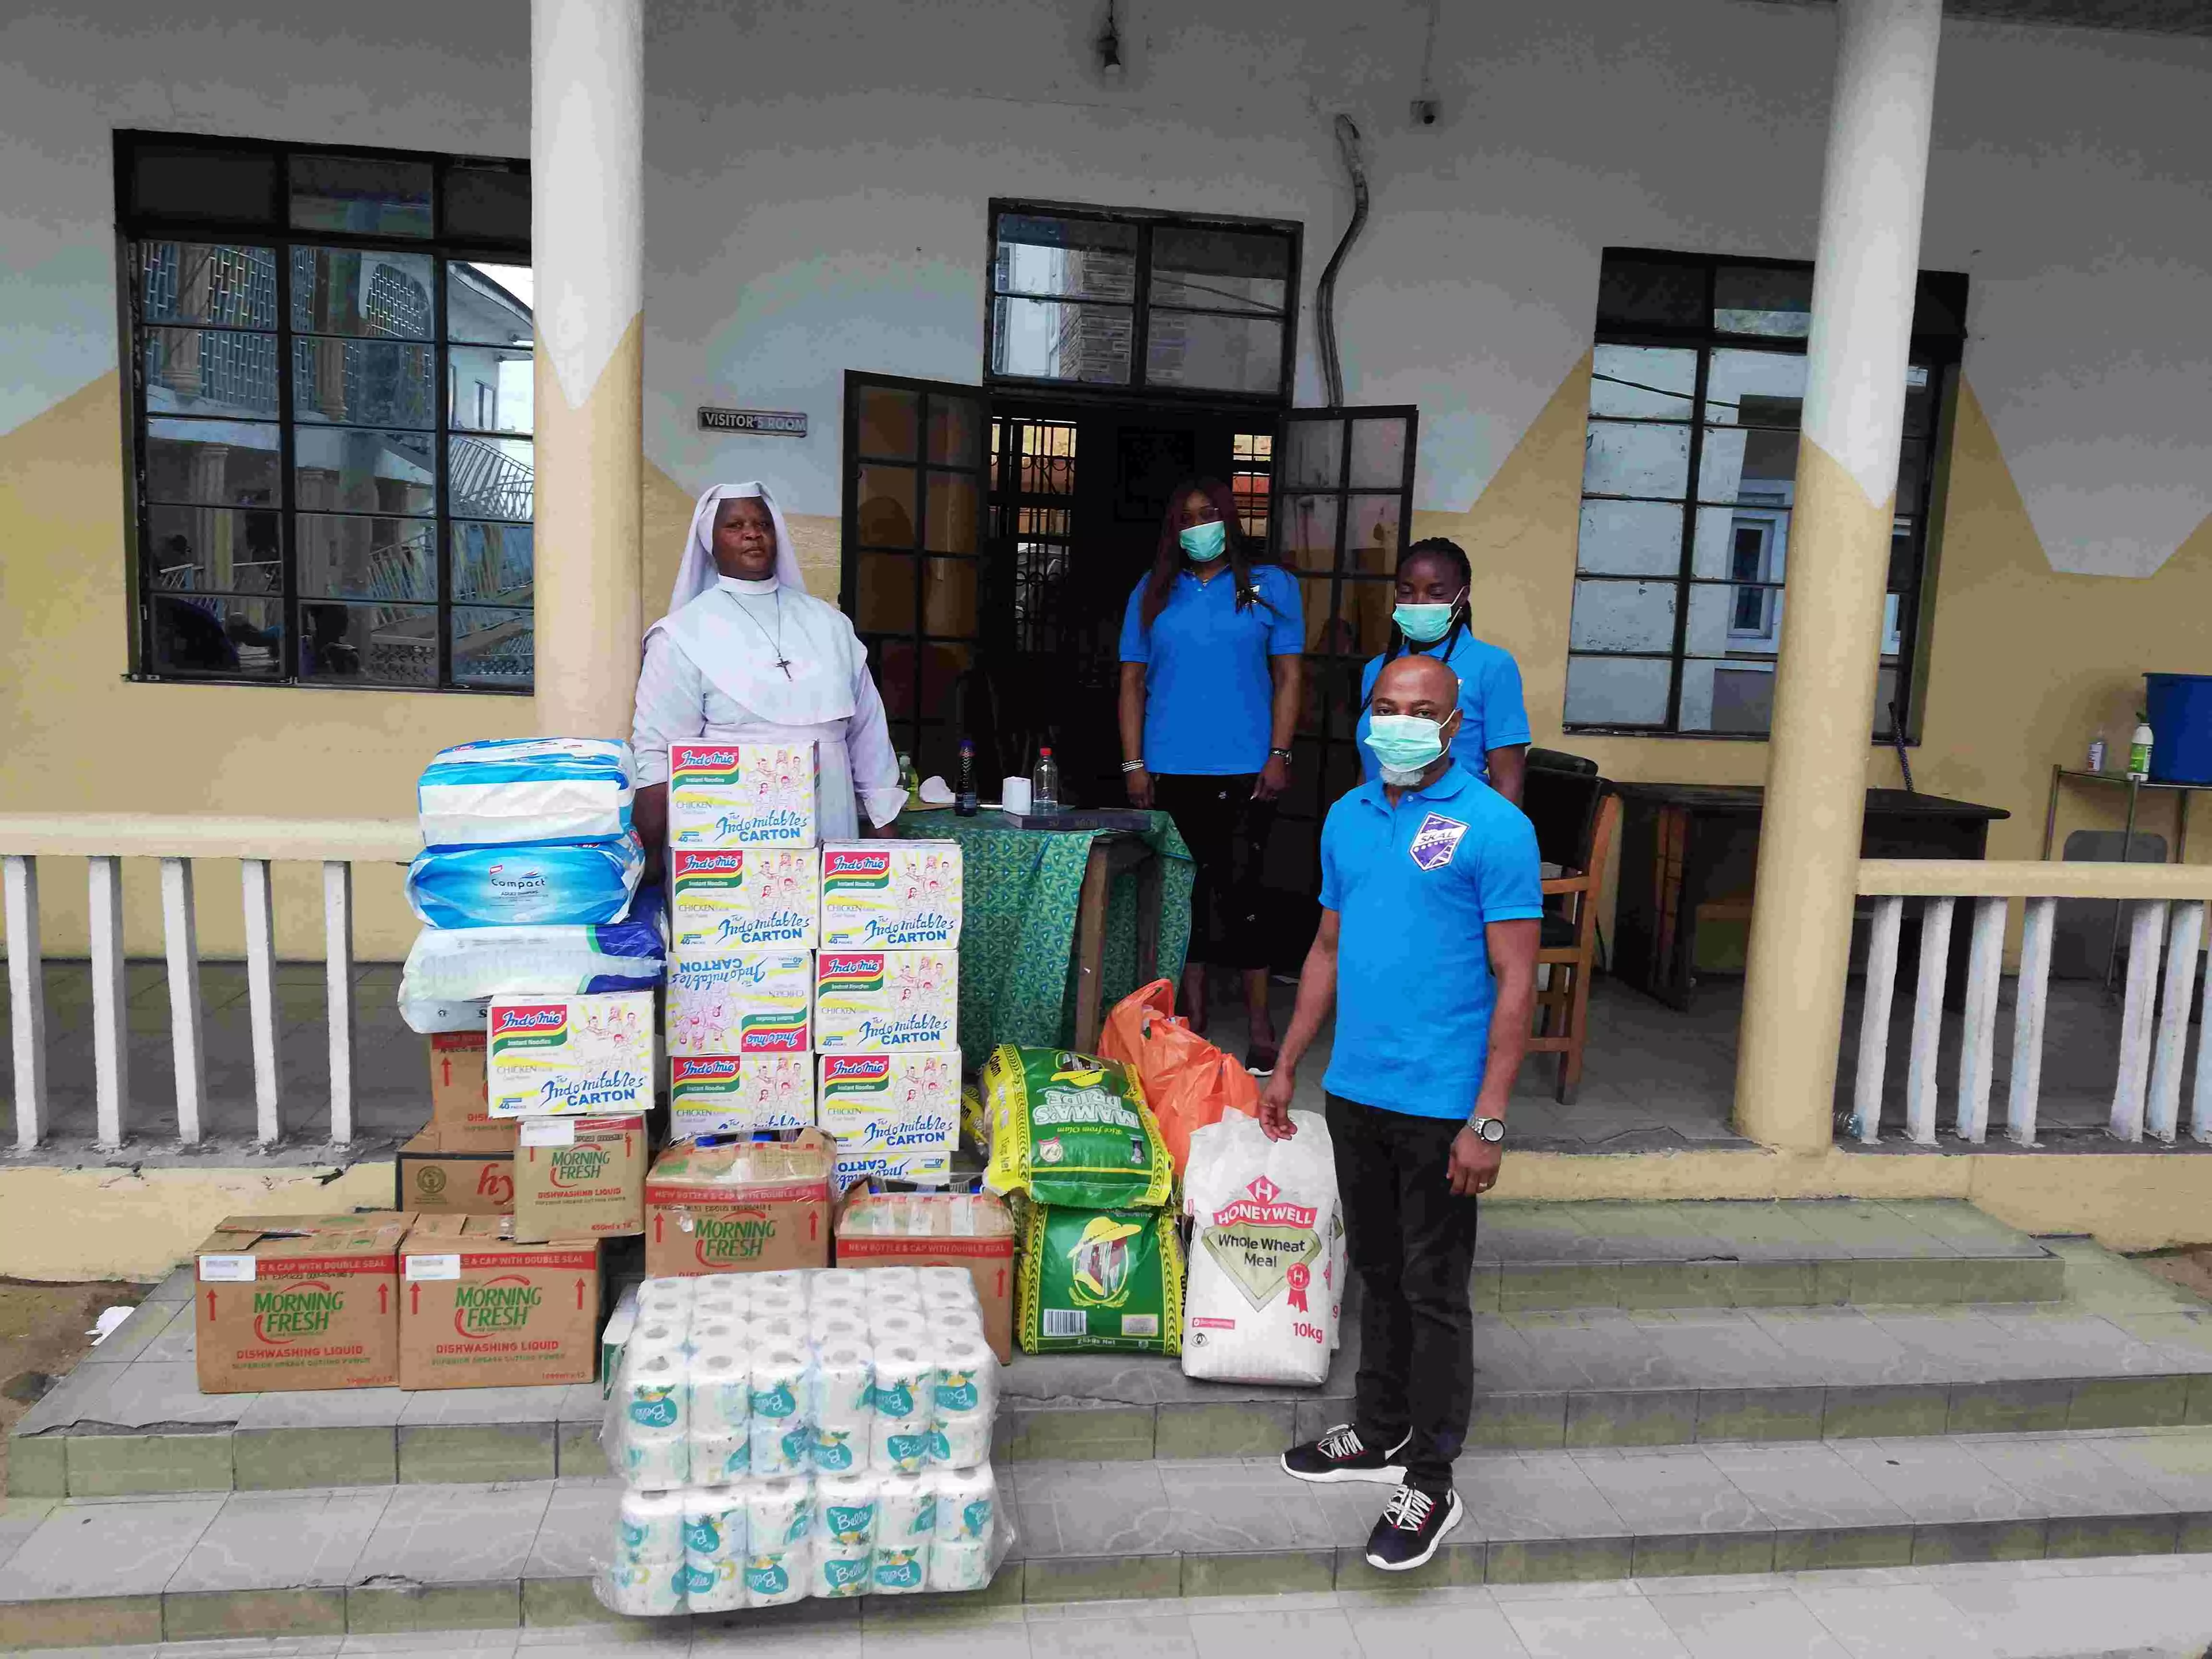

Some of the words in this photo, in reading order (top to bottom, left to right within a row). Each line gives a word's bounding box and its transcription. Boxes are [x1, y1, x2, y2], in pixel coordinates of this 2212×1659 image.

[768, 418, 806, 431] ROOM
[674, 750, 734, 769] Indomie
[714, 810, 807, 841] Indomitables
[739, 827, 800, 842] CARTON
[677, 854, 738, 875] Indomie
[826, 855, 885, 875] Indomie
[491, 878, 546, 890] Compact
[715, 910, 810, 944] Indomitables
[741, 928, 802, 943] CARTON
[863, 913, 954, 944] Indomitables
[888, 930, 946, 944] CARTON
[672, 956, 768, 990] Indomitables
[680, 958, 742, 973] CARTON
[821, 958, 879, 977] Indomie
[494, 1010, 563, 1033] Indomie
[857, 1013, 948, 1045] Indomitables
[746, 1028, 805, 1047] Indomie
[881, 1031, 940, 1045] CARTON
[676, 1060, 735, 1079] Indomie
[826, 1059, 885, 1079] Indomie
[539, 1070, 643, 1108] Indomitables
[567, 1088, 635, 1106] CARTON
[1046, 1089, 1122, 1109] PRIDE
[864, 1115, 952, 1146] Indomitables
[887, 1131, 945, 1146] CARTON
[552, 1151, 611, 1166] MORNING
[838, 1159, 887, 1172] CARTO
[559, 1165, 601, 1179] FRESH
[595, 1188, 621, 1196] LIQUID
[1255, 1183, 1272, 1201] H
[1217, 1205, 1313, 1226] HONEYWELL
[695, 1218, 779, 1239] MORNING
[706, 1237, 764, 1257] FRESH
[870, 1243, 900, 1252] BOTTLE
[910, 1244, 927, 1252] CAP
[928, 1245, 950, 1253] WITH
[1218, 1234, 1259, 1250] Whole
[1261, 1238, 1305, 1253] Wheat
[277, 1263, 296, 1271] CAP
[298, 1262, 324, 1270] WITH
[325, 1261, 361, 1269] DOUBLE
[362, 1259, 386, 1268] SEAL
[480, 1257, 497, 1265] CAP
[499, 1256, 523, 1265] WITH
[525, 1255, 559, 1264] DOUBLE
[561, 1254, 584, 1263] SEAL
[1244, 1254, 1277, 1268] Meal
[254, 1291, 345, 1313] MORNING
[455, 1286, 542, 1308] MORNING
[266, 1312, 330, 1332] FRESH
[467, 1307, 529, 1328] FRESH
[1293, 1322, 1323, 1343] 10kg
[237, 1347, 320, 1360] DISHWASHING
[324, 1346, 363, 1356] LIQUID
[436, 1342, 517, 1354] DISHWASHING
[521, 1340, 559, 1350] LIQUID
